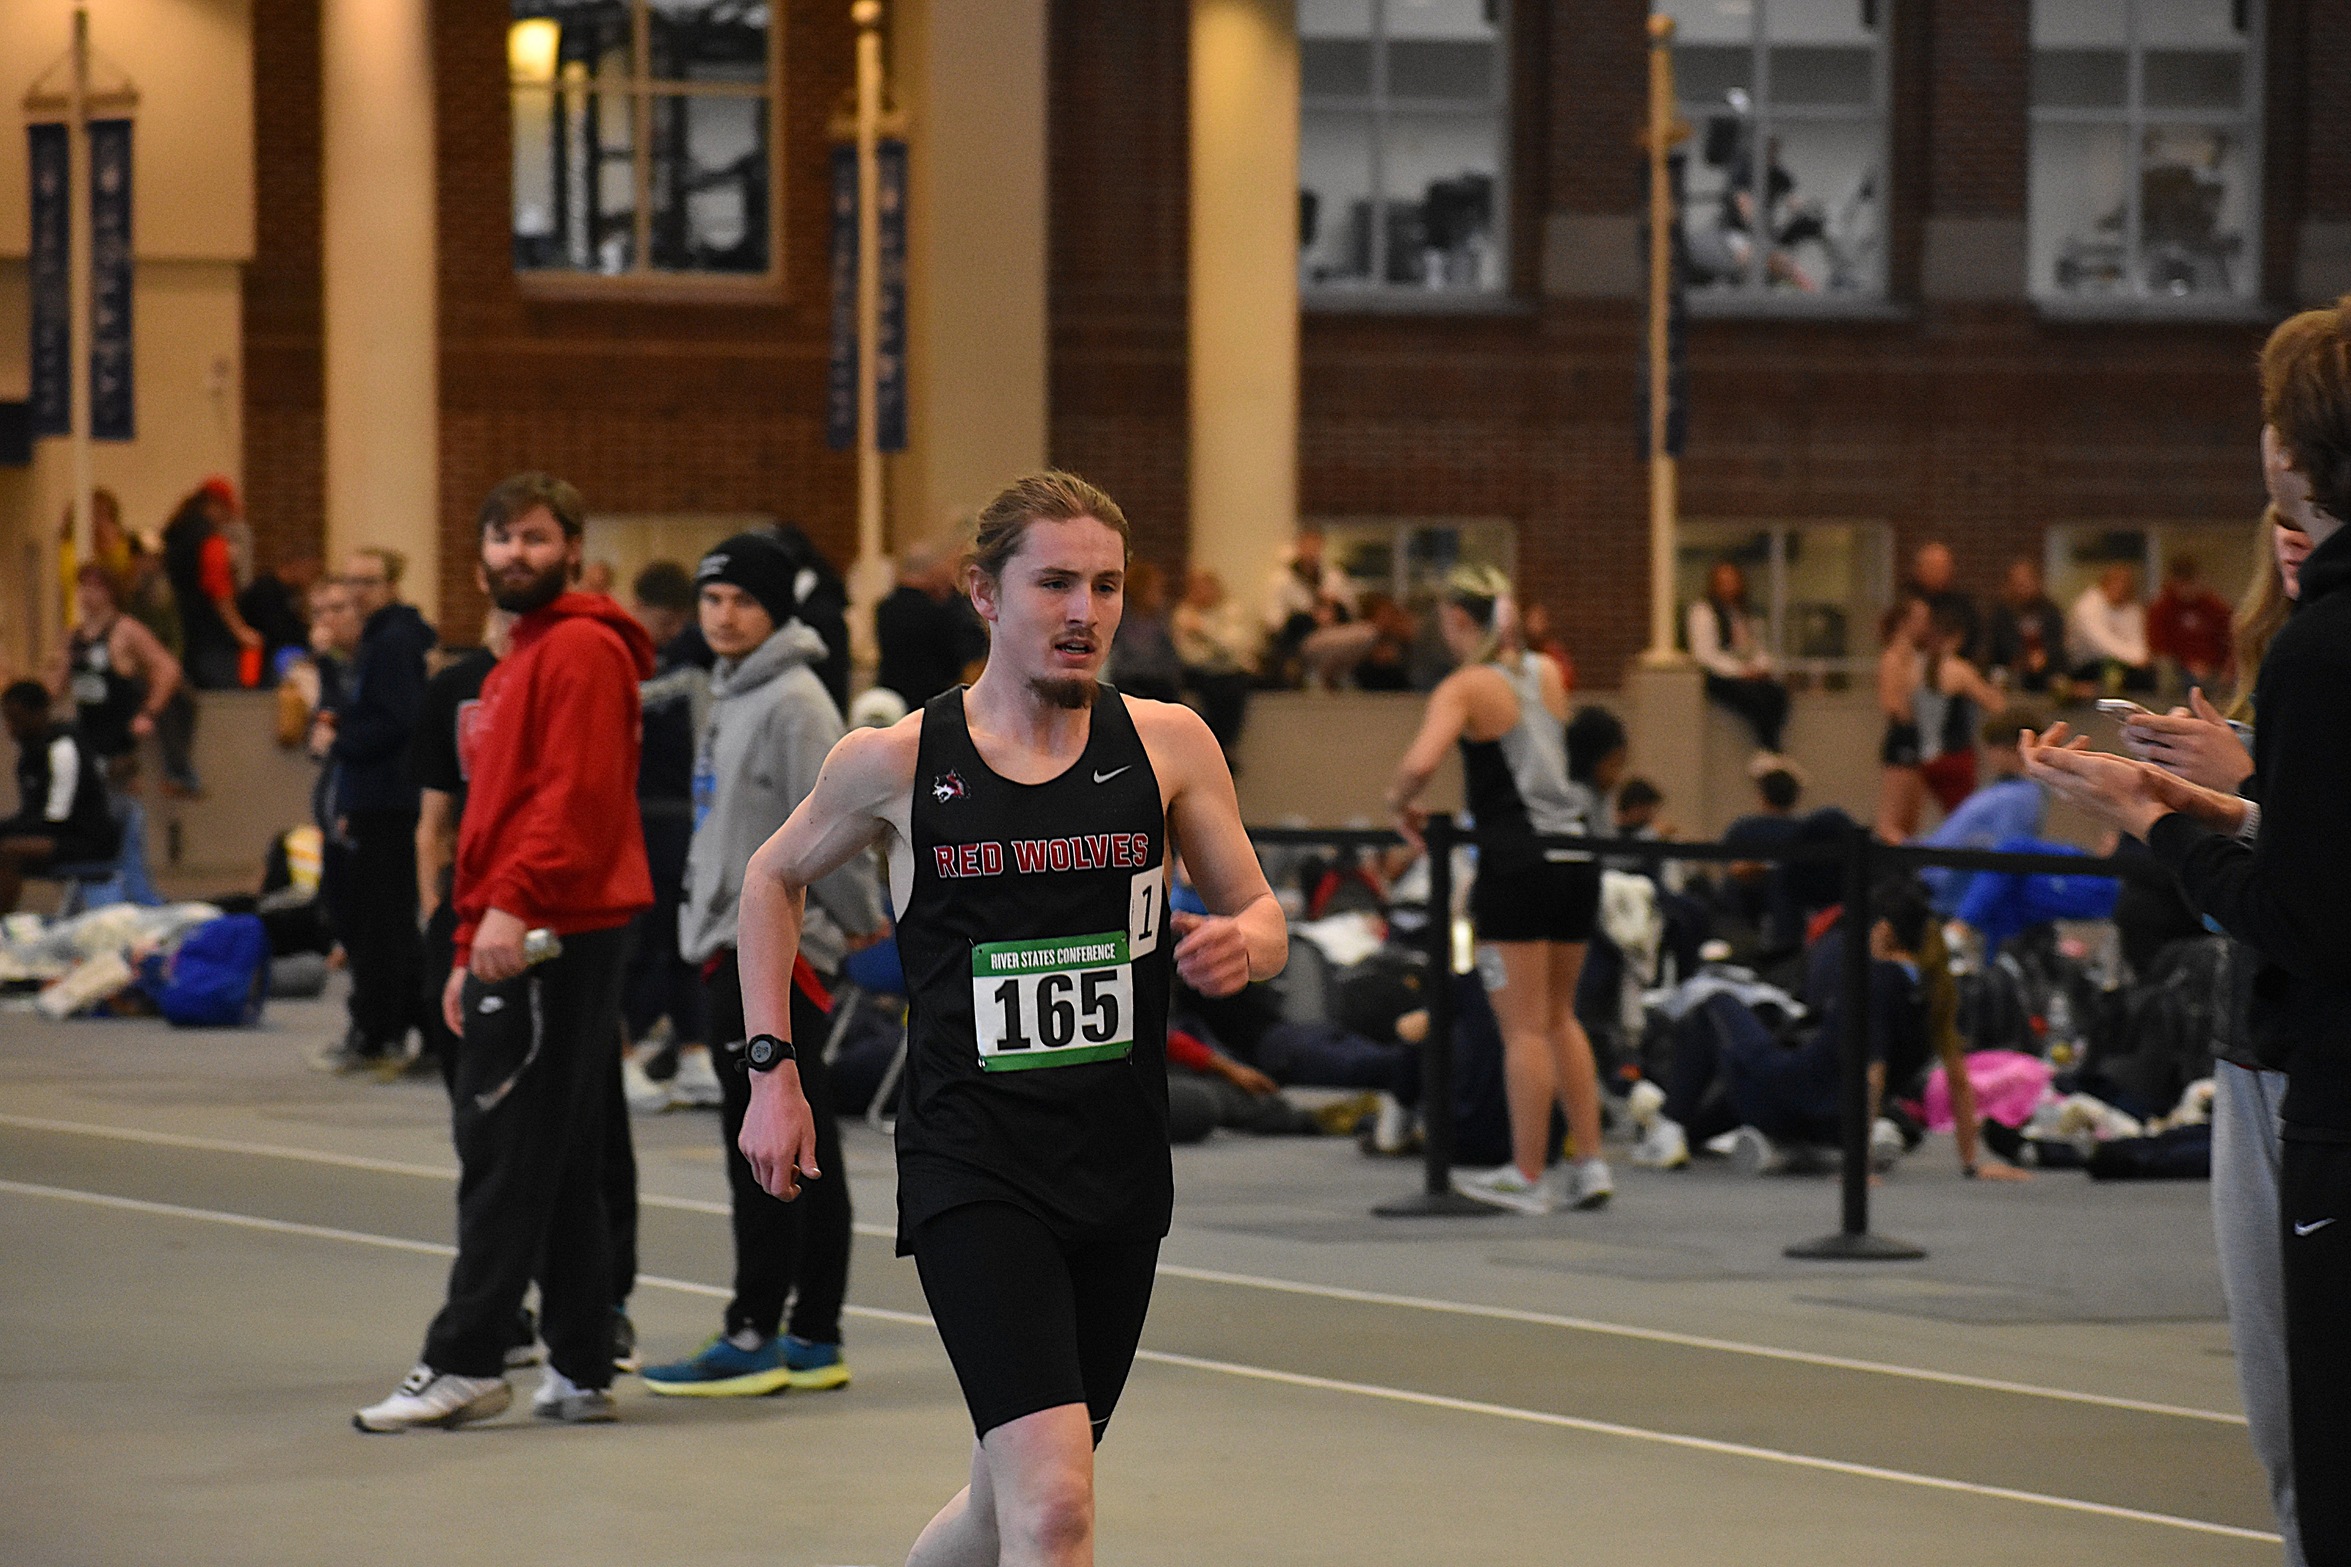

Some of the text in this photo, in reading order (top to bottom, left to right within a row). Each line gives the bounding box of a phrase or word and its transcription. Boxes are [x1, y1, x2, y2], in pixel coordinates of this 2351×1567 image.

[934, 833, 1149, 878] RED WOLVES
[1138, 885, 1153, 941] 1
[991, 943, 1116, 970] RIVER STATES CONFERENCE
[994, 969, 1119, 1051] 165
